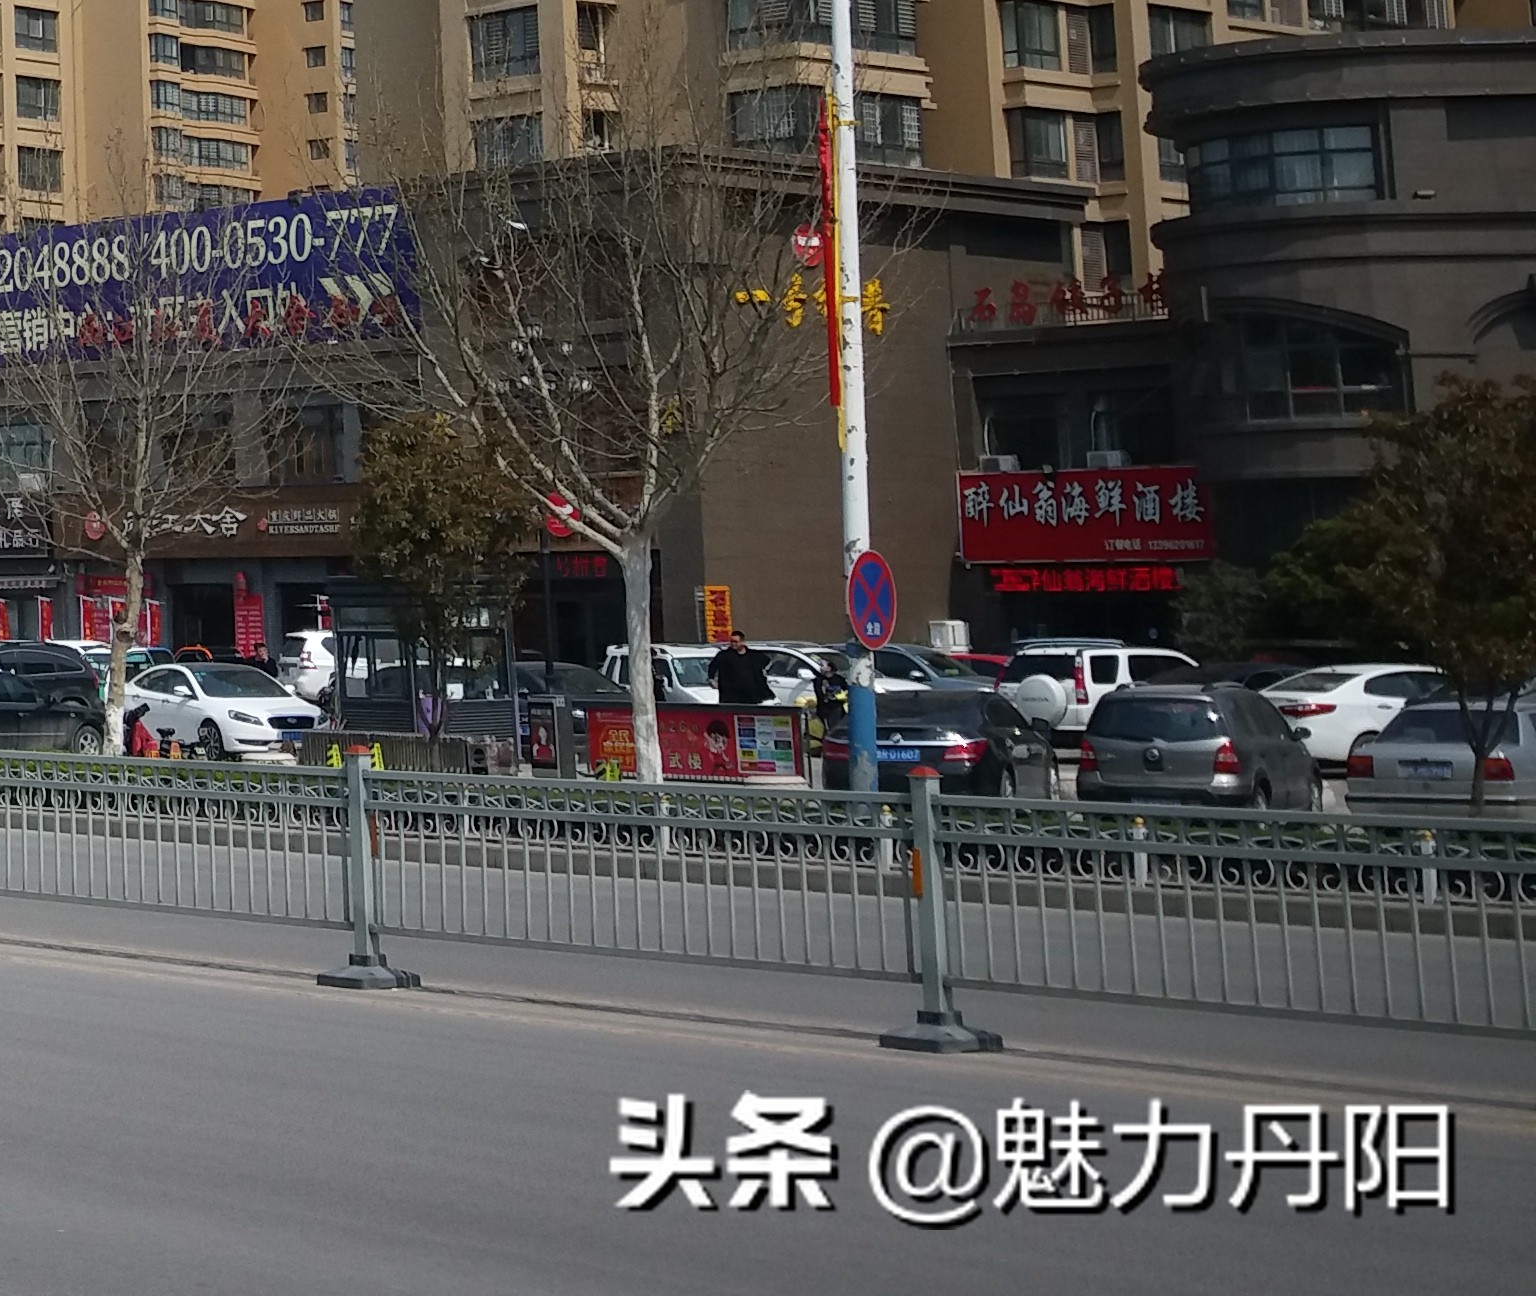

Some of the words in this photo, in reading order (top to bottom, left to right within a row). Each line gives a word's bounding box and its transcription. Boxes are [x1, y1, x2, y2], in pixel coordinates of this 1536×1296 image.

[963, 478, 1206, 528] 醉仙翁海鲜酒楼
